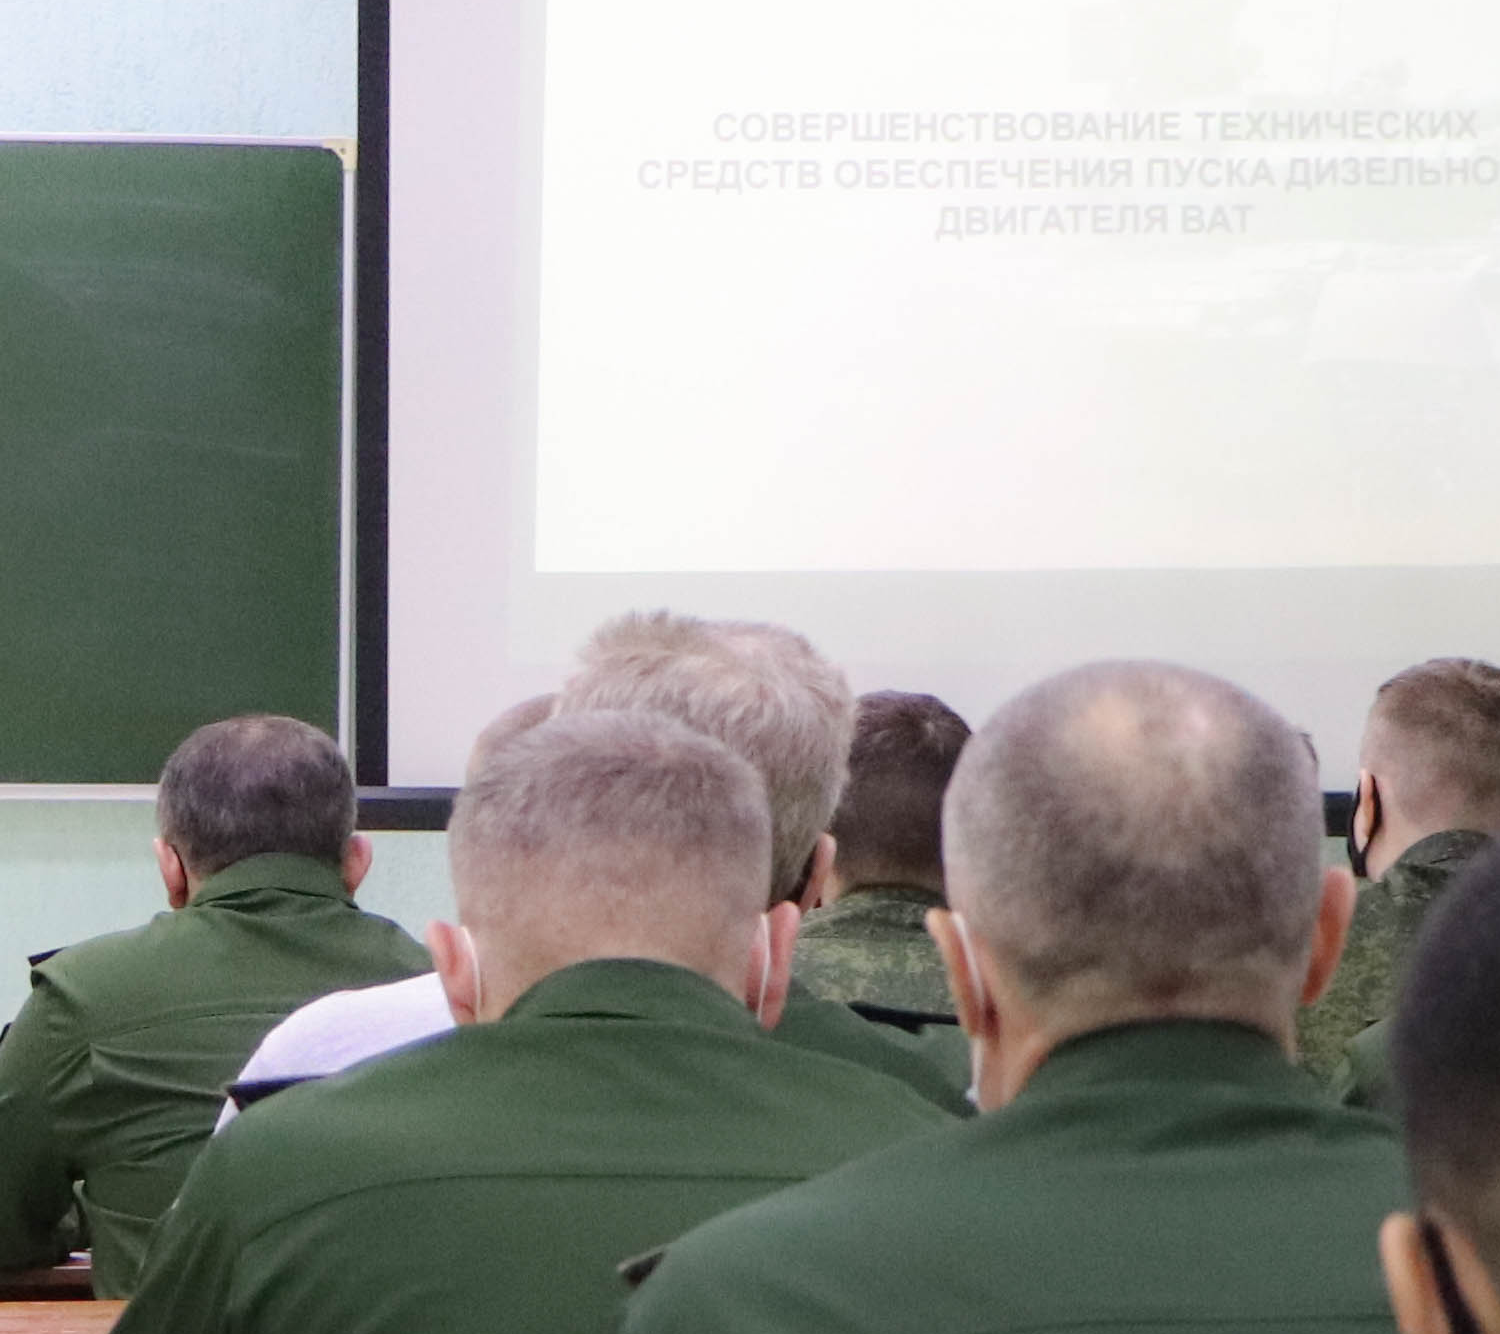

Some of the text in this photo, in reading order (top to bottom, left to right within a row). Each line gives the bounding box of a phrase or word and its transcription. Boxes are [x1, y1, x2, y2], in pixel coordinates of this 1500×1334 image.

[712, 110, 1478, 142] СОВЕРШЕНСТВОВАНИЕ ТЕХНИЧЕСКИХ
[637, 160, 823, 194] СРЕДСТВ
[834, 159, 1133, 189] ОБЕСПЕЧЕНИЯ
[1147, 158, 1276, 187] ПУСКА
[934, 204, 1254, 241] ДВИГАТЕЛЯ ВАТ
